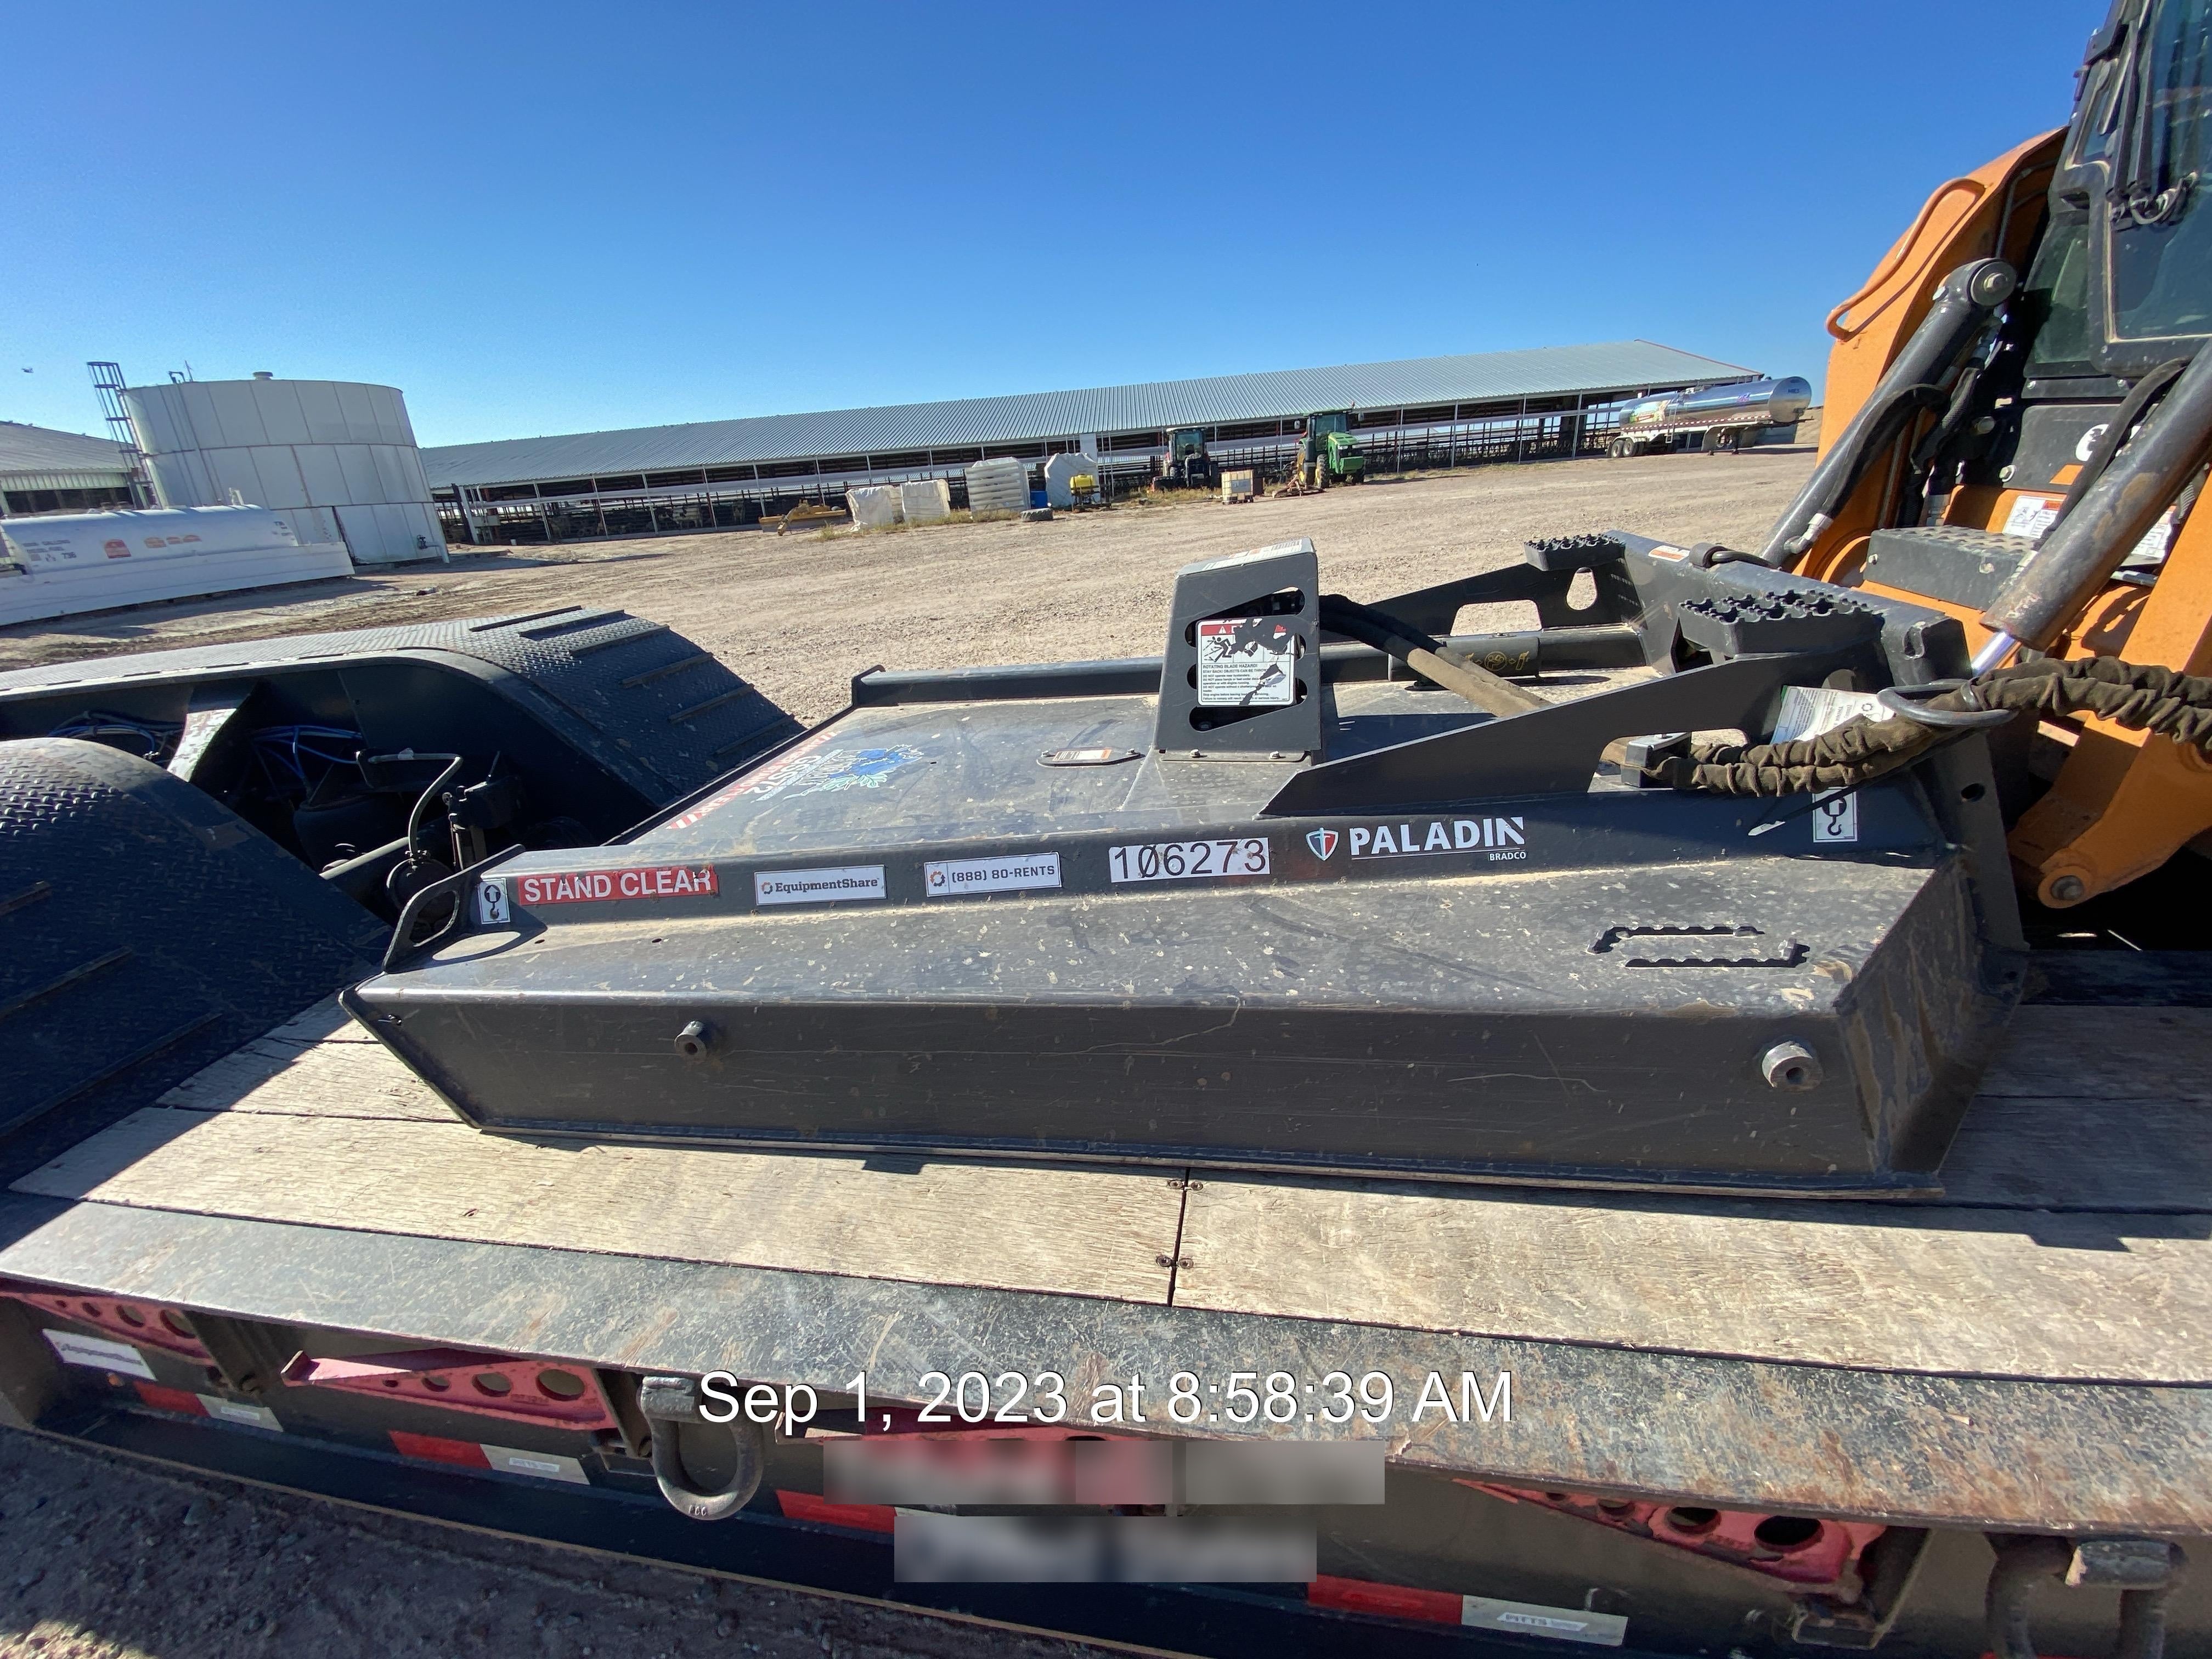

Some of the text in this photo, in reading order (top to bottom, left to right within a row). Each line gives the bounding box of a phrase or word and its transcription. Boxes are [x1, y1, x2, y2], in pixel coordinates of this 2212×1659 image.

[738, 764, 780, 787] STAND
[743, 755, 822, 794] GSS72
[692, 787, 745, 815] CLEAR
[1349, 817, 1525, 856] PALADIN
[1114, 839, 1266, 879] 106273
[1489, 851, 1526, 861] BRADCO
[524, 869, 711, 902] STAND CLEAR
[775, 878, 878, 894] EquipmentShare
[952, 865, 1055, 883] (888) 80-RENTS
